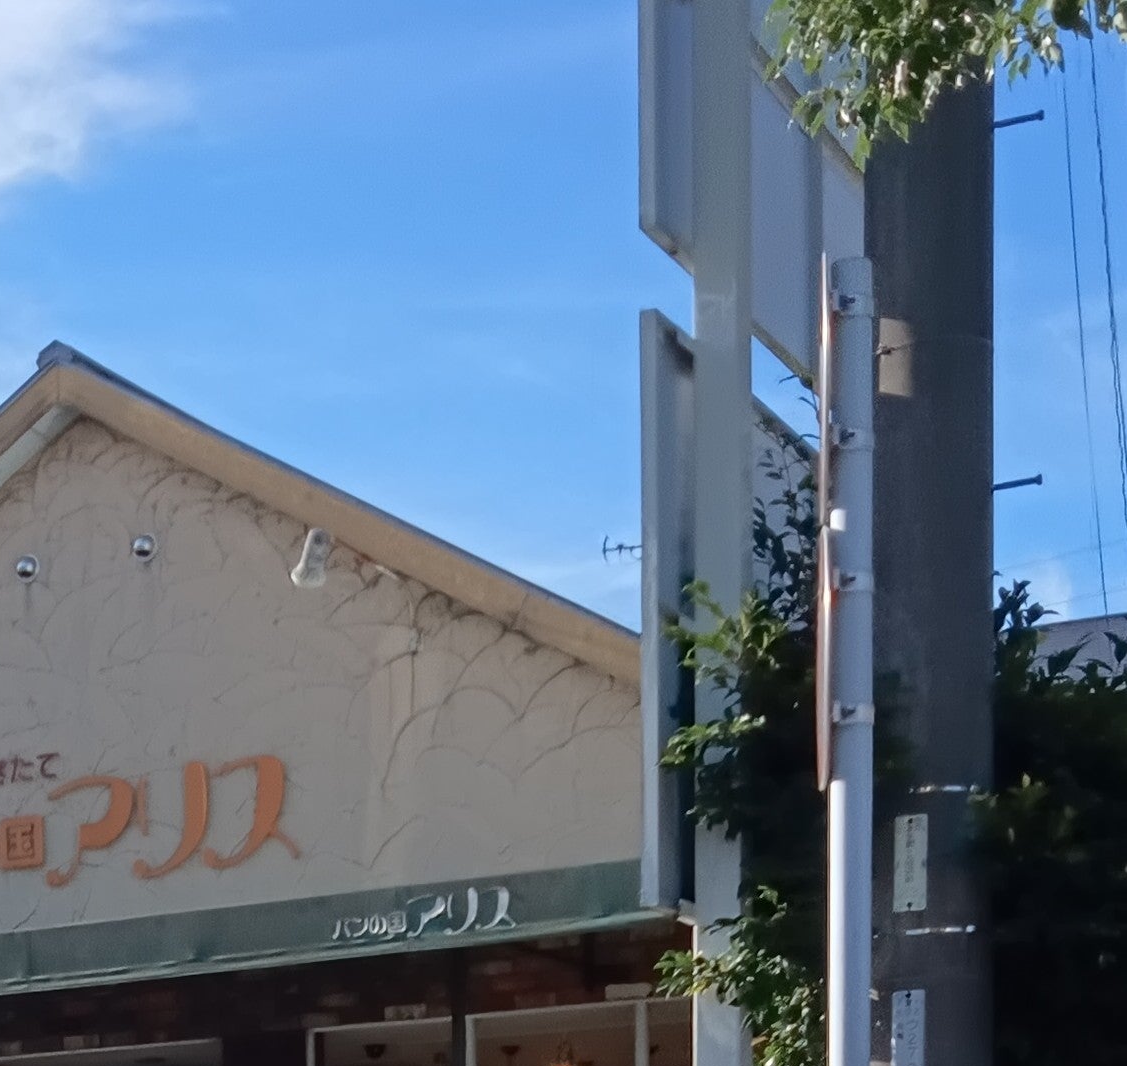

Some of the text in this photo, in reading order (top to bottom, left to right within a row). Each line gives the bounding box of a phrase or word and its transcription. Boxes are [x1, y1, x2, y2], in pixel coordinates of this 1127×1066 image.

[46, 755, 301, 887] アリス
[406, 887, 516, 938] アリス
